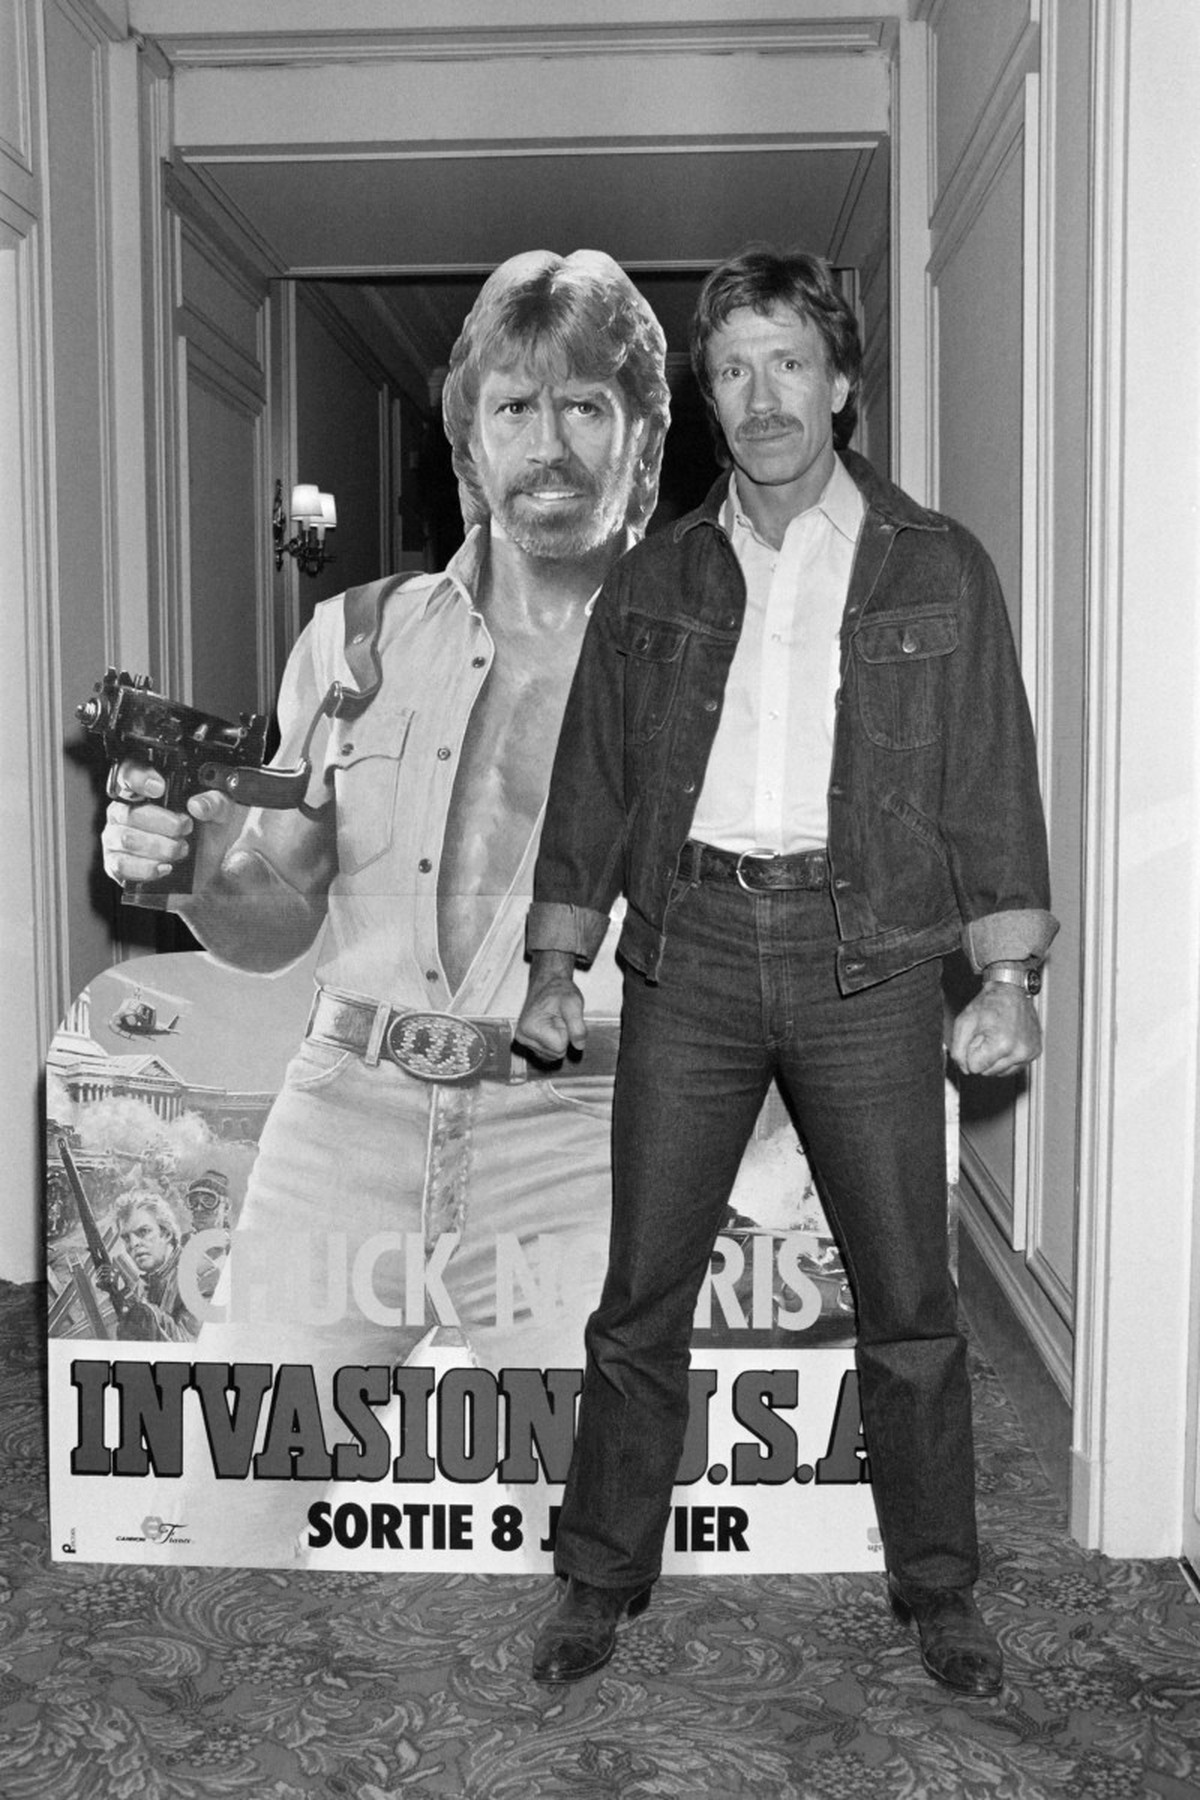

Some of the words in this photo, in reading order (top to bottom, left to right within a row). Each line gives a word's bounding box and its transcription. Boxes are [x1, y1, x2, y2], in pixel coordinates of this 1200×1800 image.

[178, 1228, 461, 1327] CHUCK
[496, 1233, 822, 1331] NRIS
[70, 1359, 584, 1485] INVASION
[307, 1501, 474, 1551] SORTIE
[492, 1504, 524, 1552] 8
[540, 1505, 750, 1553] JIER
